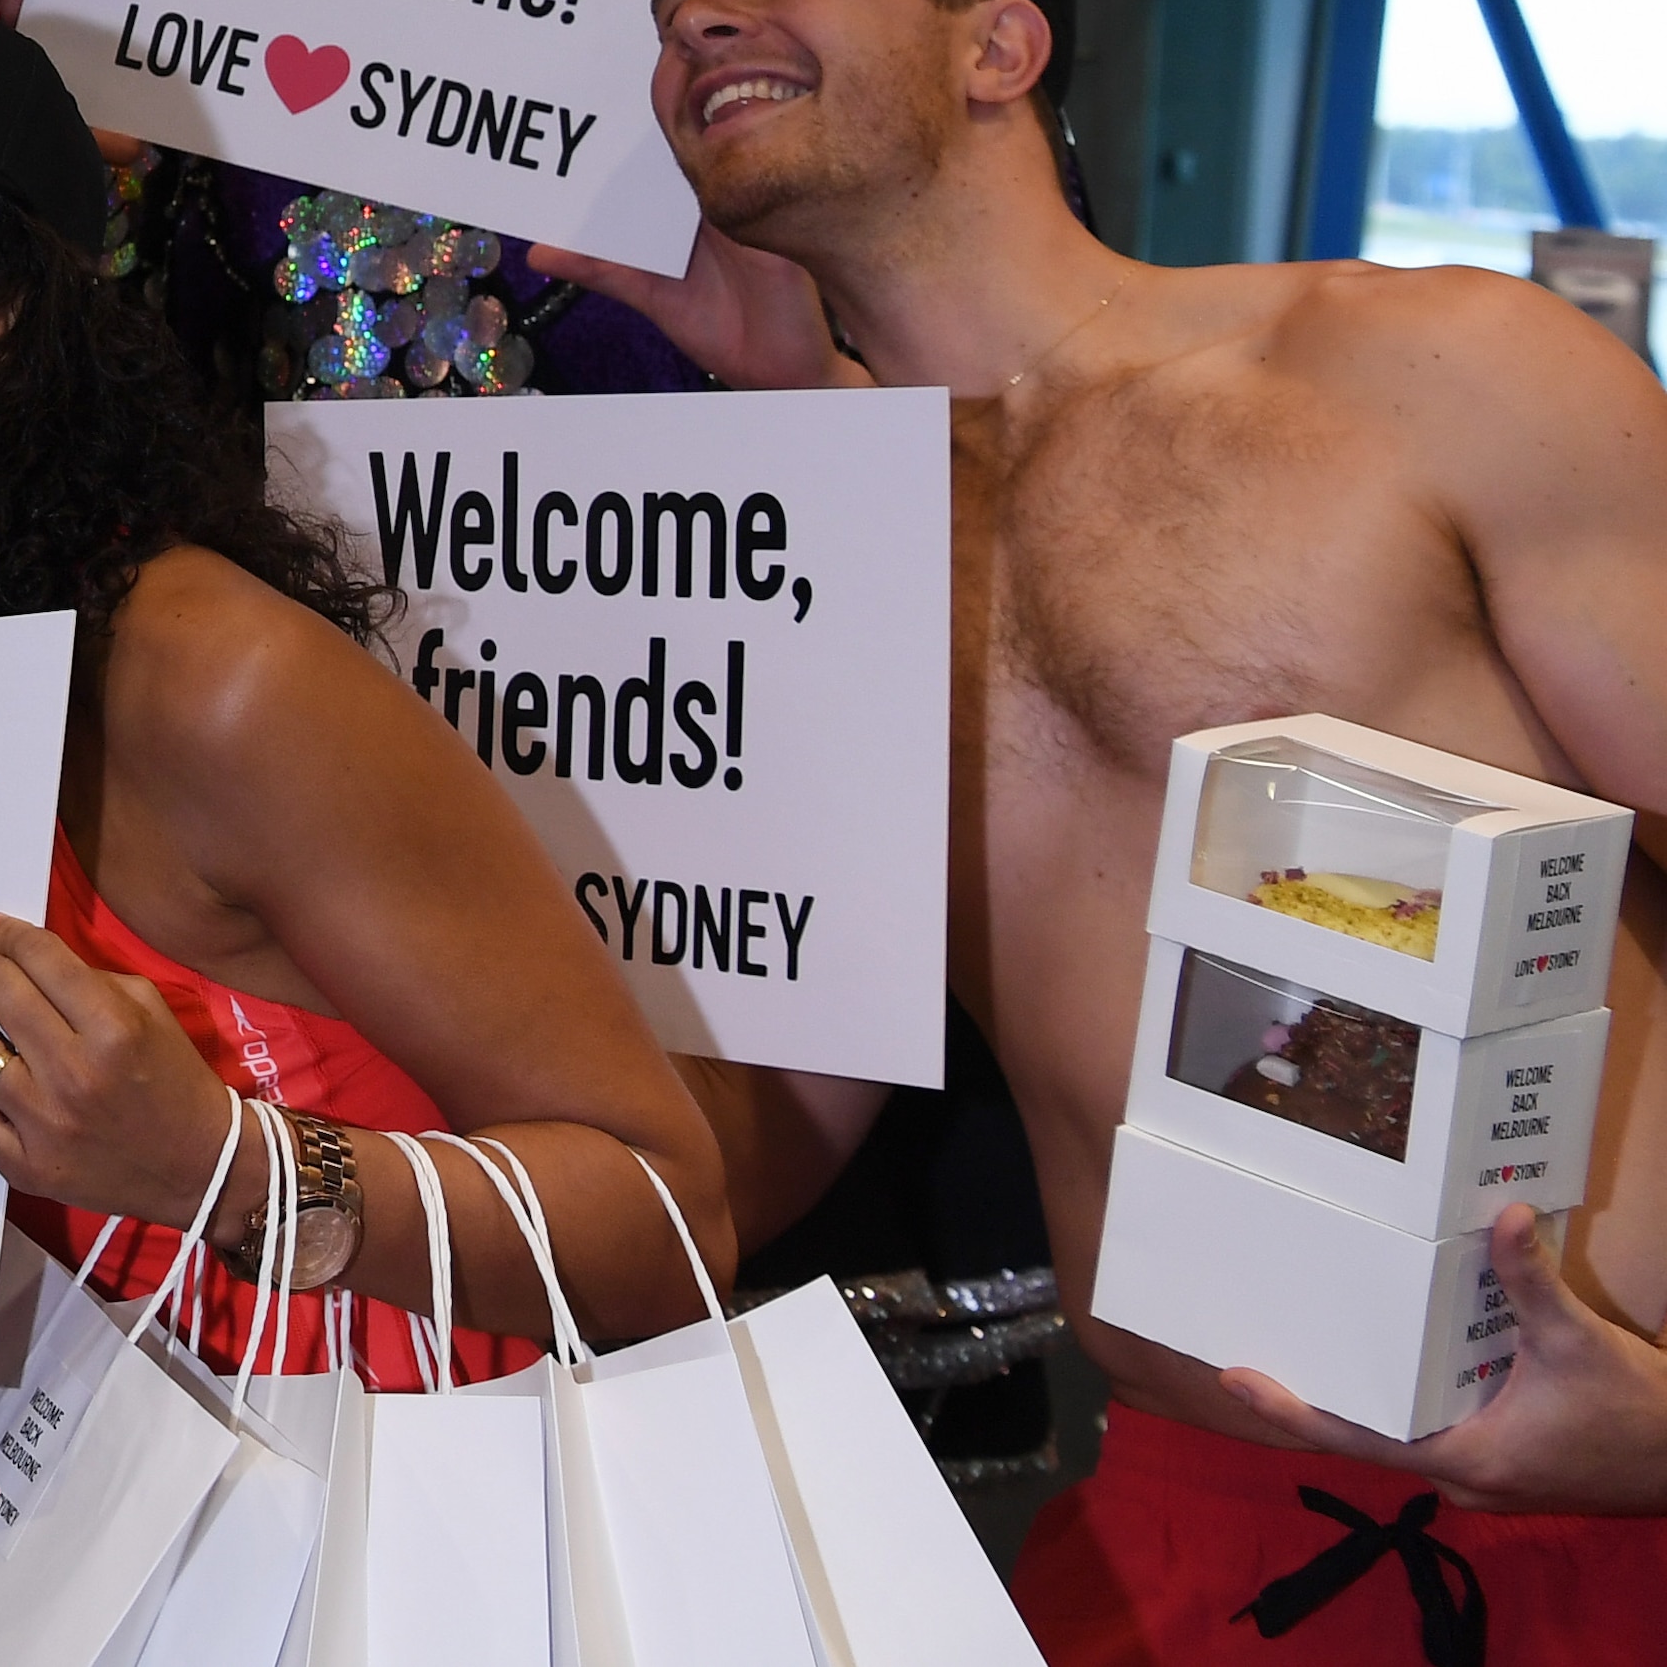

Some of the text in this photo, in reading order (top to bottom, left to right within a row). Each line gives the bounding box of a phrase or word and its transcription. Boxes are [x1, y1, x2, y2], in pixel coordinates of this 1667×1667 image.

[114, 3, 597, 178] LOVE SYDNEY
[369, 451, 813, 624] Welcome,
[412, 628, 745, 792] friends!
[1540, 854, 1585, 878] WELCOME
[1546, 882, 1572, 903] BACK
[575, 872, 815, 982] SYDNEY
[1527, 905, 1583, 932] MELBOURNE
[1515, 950, 1581, 977] LOVE SYDNEY
[1506, 1065, 1554, 1088] WELCOME
[1512, 1093, 1539, 1113] BACK
[1491, 1116, 1551, 1141] MELBOURNE
[1479, 1161, 1548, 1186] LOVE SYDNEY
[1456, 1367, 1477, 1388] LOVE
[29, 1386, 64, 1430] WELCOME
[20, 1416, 44, 1447] BACK
